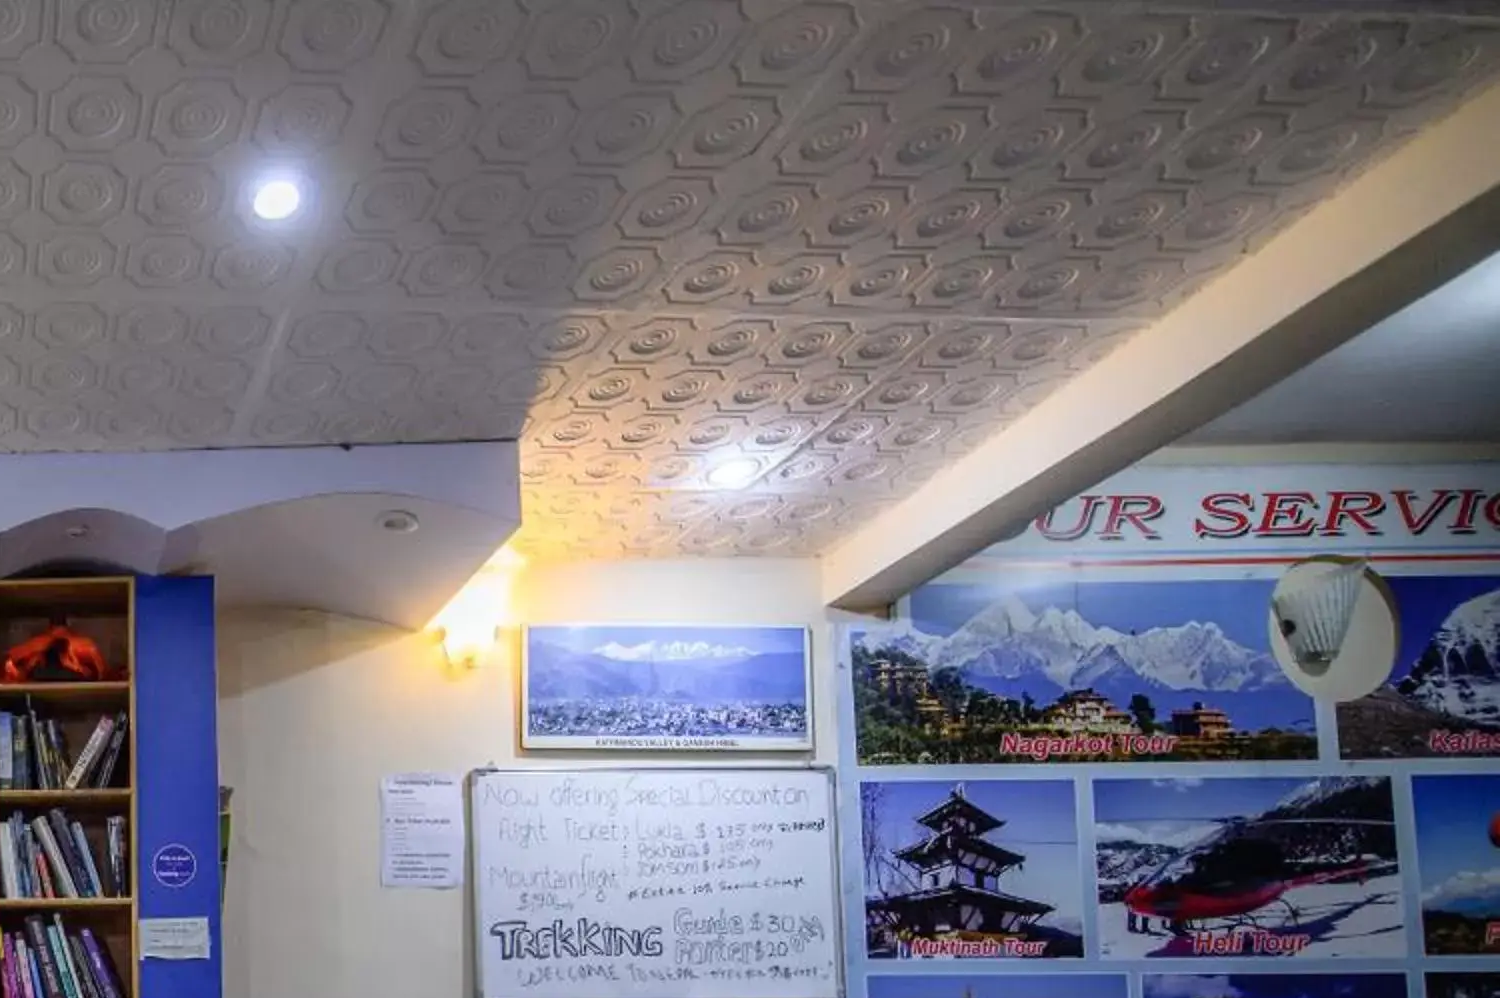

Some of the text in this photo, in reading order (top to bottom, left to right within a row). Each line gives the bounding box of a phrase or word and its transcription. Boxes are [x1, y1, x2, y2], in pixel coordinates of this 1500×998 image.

[1033, 494, 1166, 541] UR
[999, 731, 1179, 756] Nagarkot Tour
[910, 936, 1045, 958] Muktinath Tour
[1193, 930, 1310, 954] Heli Tour
